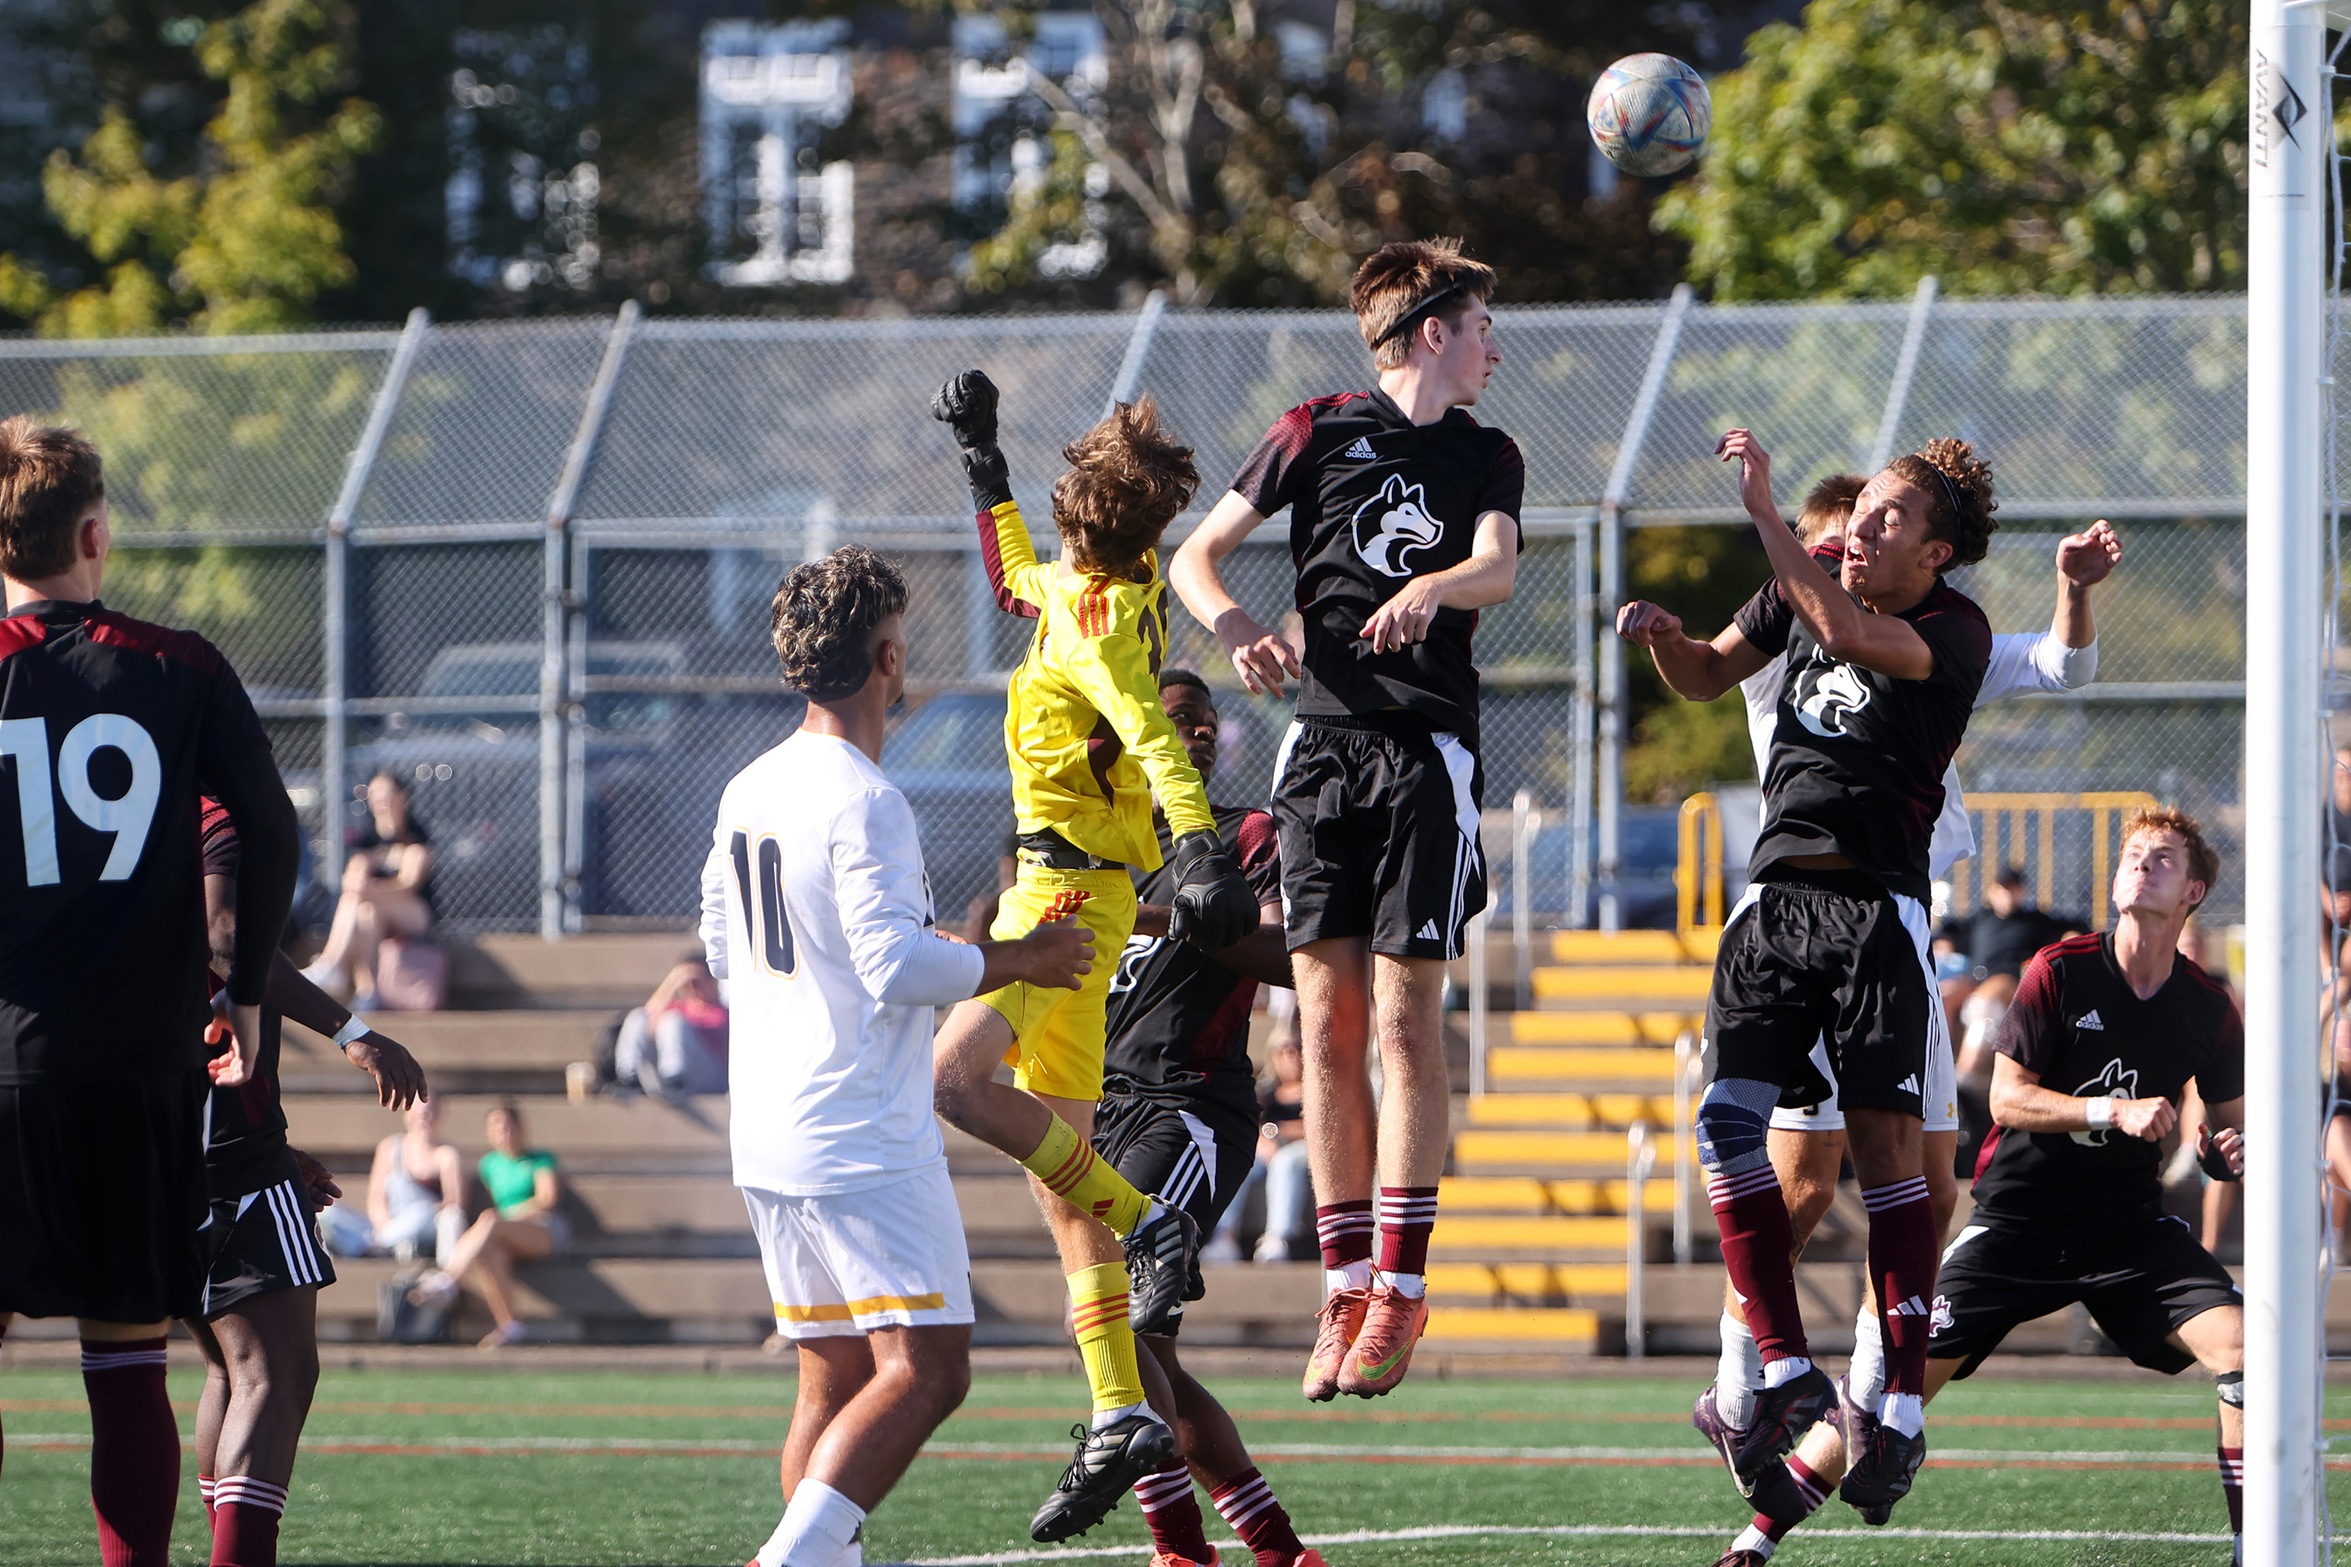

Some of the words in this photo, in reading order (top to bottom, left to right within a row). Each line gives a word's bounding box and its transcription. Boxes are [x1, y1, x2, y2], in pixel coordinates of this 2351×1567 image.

[2255, 48, 2268, 168] AVANTI
[1345, 450, 1377, 459] adidas
[0, 713, 162, 886] 19
[729, 827, 798, 979] 10
[2075, 1020, 2104, 1031] adidas
